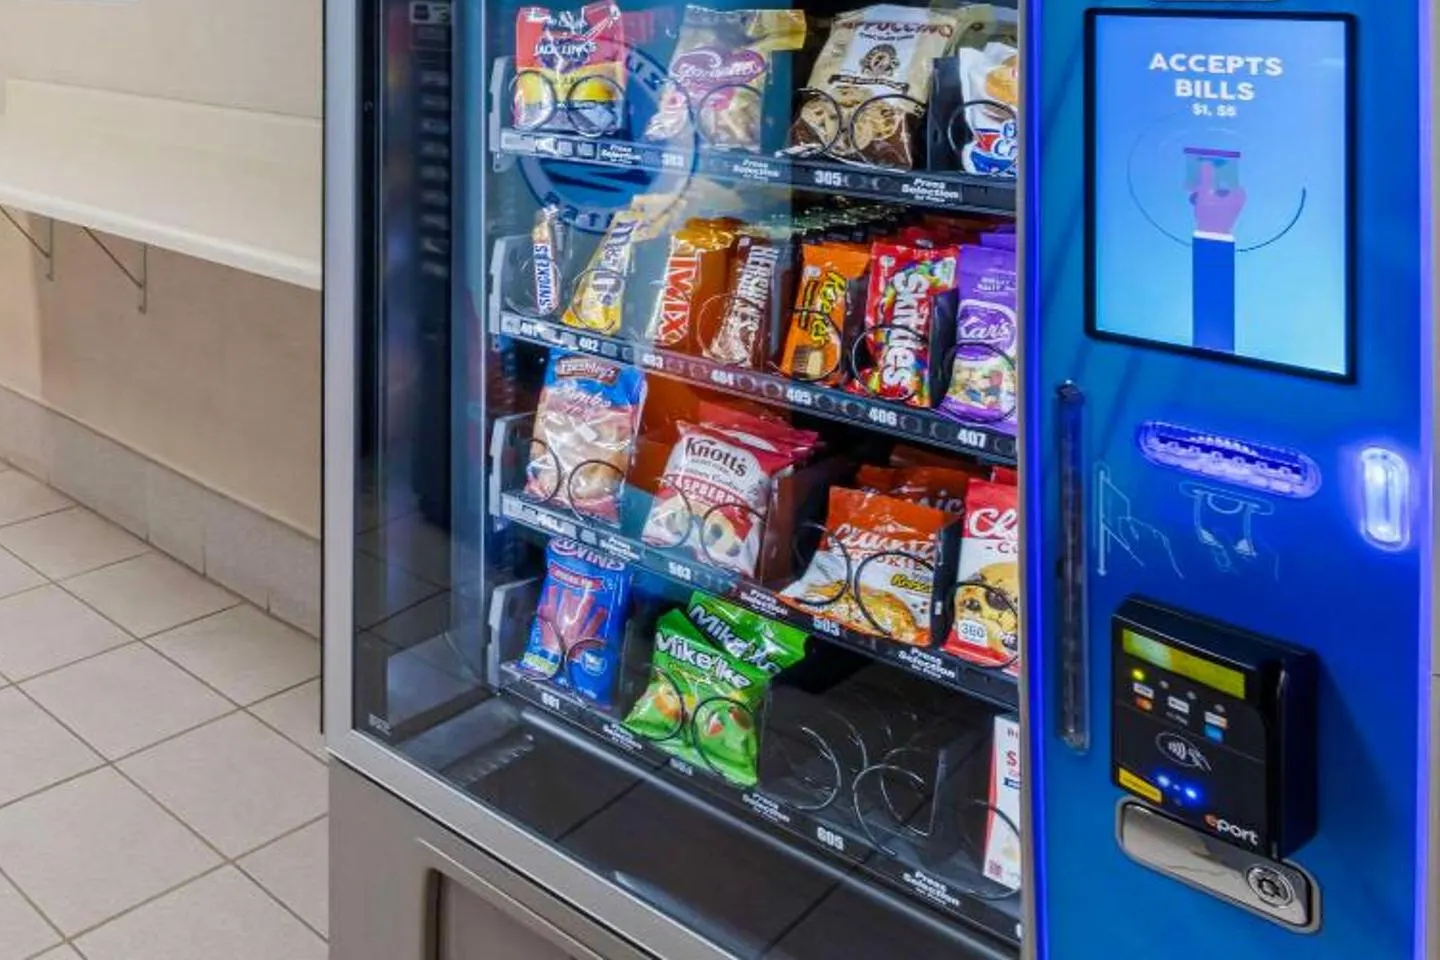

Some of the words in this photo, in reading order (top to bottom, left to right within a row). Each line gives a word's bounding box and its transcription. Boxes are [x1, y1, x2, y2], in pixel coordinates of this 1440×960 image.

[1148, 52, 1284, 77] ACCEPTS
[1174, 78, 1255, 101] BILLS
[814, 170, 844, 186] 305
[659, 253, 701, 345] TWIX
[880, 271, 930, 388] Skittles
[959, 316, 1010, 339] Kar's
[786, 388, 812, 406] 405
[868, 407, 898, 427] 406
[957, 428, 986, 449] 407
[685, 437, 748, 477] Knott's
[666, 475, 745, 505] ASPBERR
[656, 631, 712, 670] Mike
[1204, 813, 1259, 845] eport
